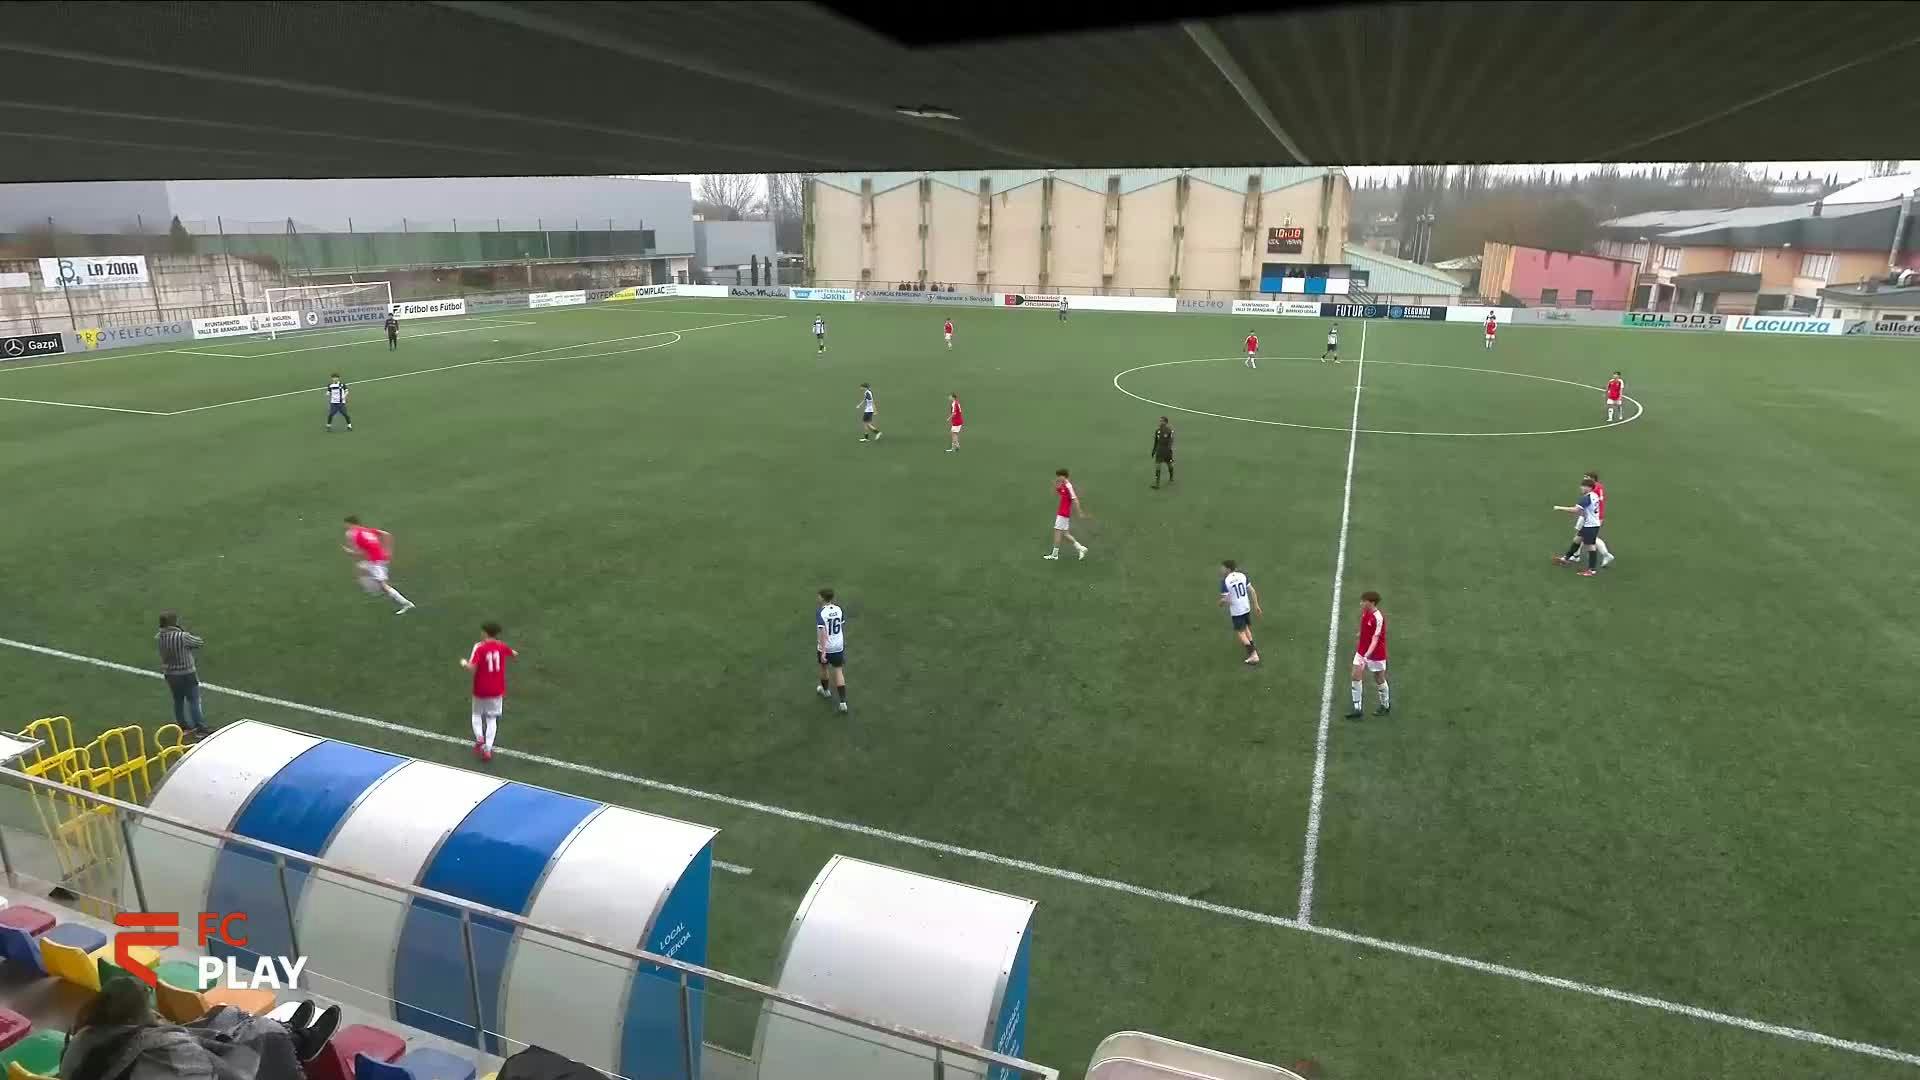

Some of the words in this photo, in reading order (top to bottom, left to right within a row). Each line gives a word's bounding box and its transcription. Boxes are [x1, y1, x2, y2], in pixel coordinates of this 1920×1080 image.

[88, 264, 103, 276] LA
[107, 262, 138, 275] ZONA
[404, 304, 428, 314] Fútbol
[440, 302, 462, 311] Fútbol
[324, 312, 385, 323] MUTILVERA
[1628, 313, 1722, 325] TOLDOS
[29, 338, 58, 350] Gazpi
[1232, 582, 1246, 599] 10
[827, 617, 841, 635] 16
[486, 650, 501, 672] 11
[660, 922, 685, 950] LOCAL
